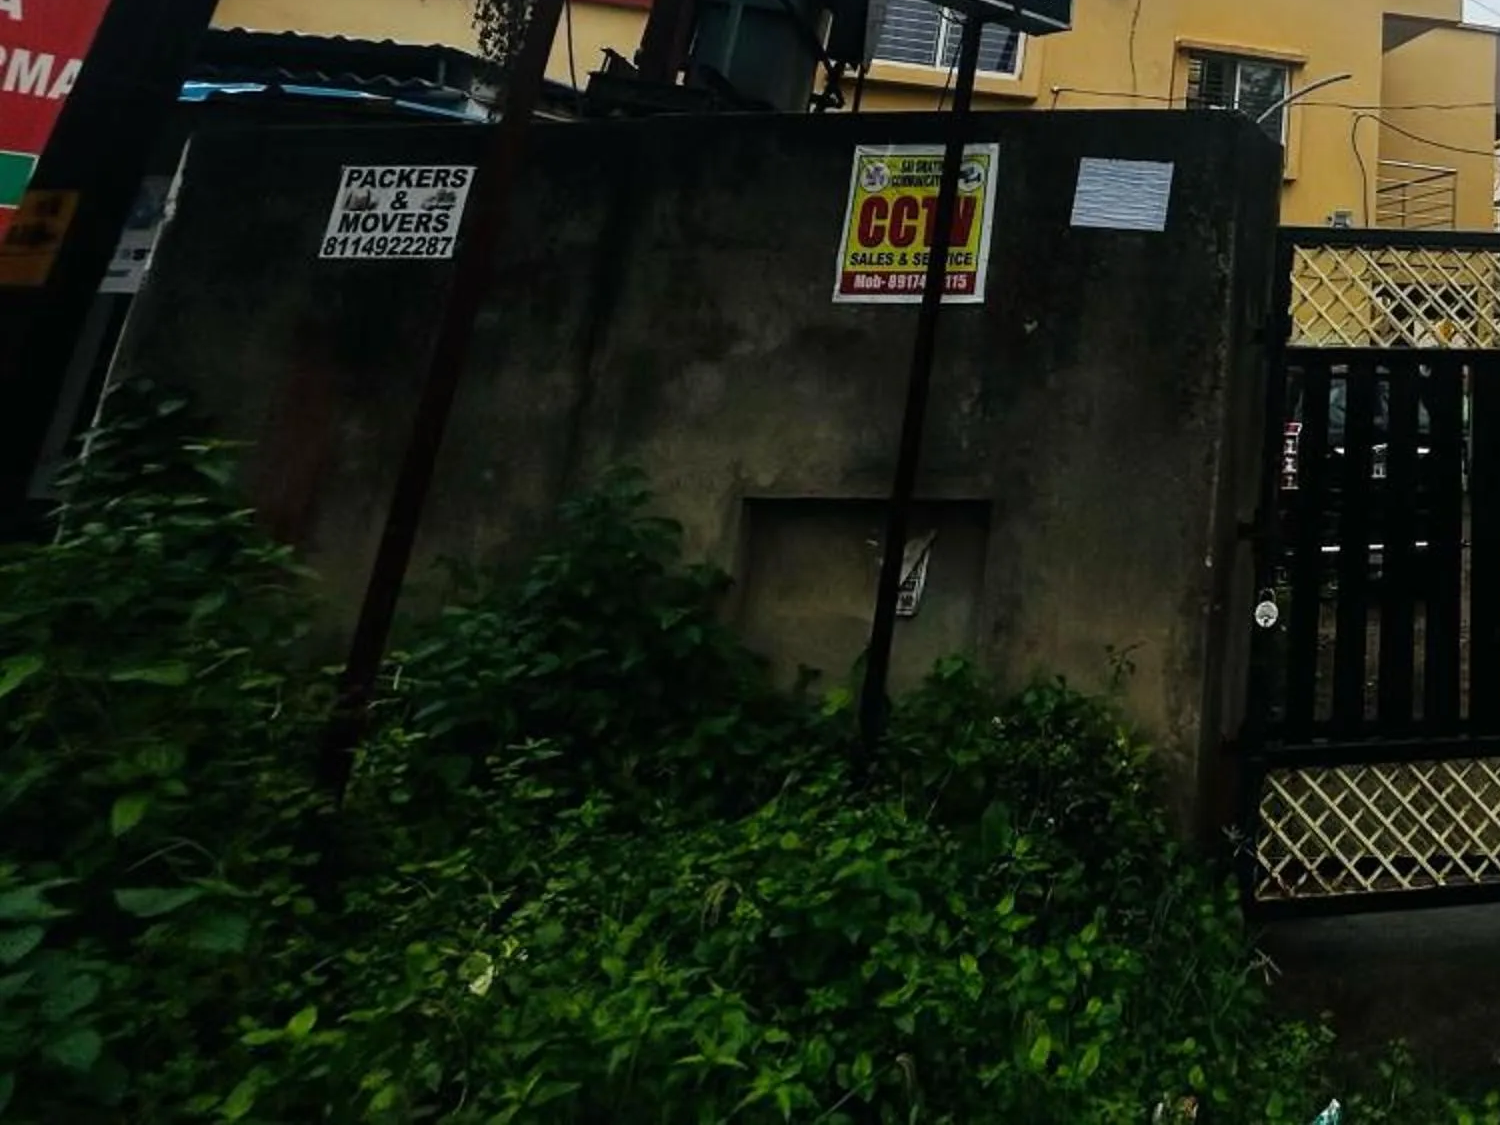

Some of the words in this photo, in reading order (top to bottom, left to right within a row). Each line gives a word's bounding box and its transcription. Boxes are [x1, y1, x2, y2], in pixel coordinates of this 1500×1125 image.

[345, 168, 469, 188] PACKERS
[390, 190, 408, 210] &
[338, 213, 450, 233] MOVERS
[323, 236, 453, 256] 8114922287
[849, 252, 894, 265] SALES
[911, 252, 972, 265] SEICE
